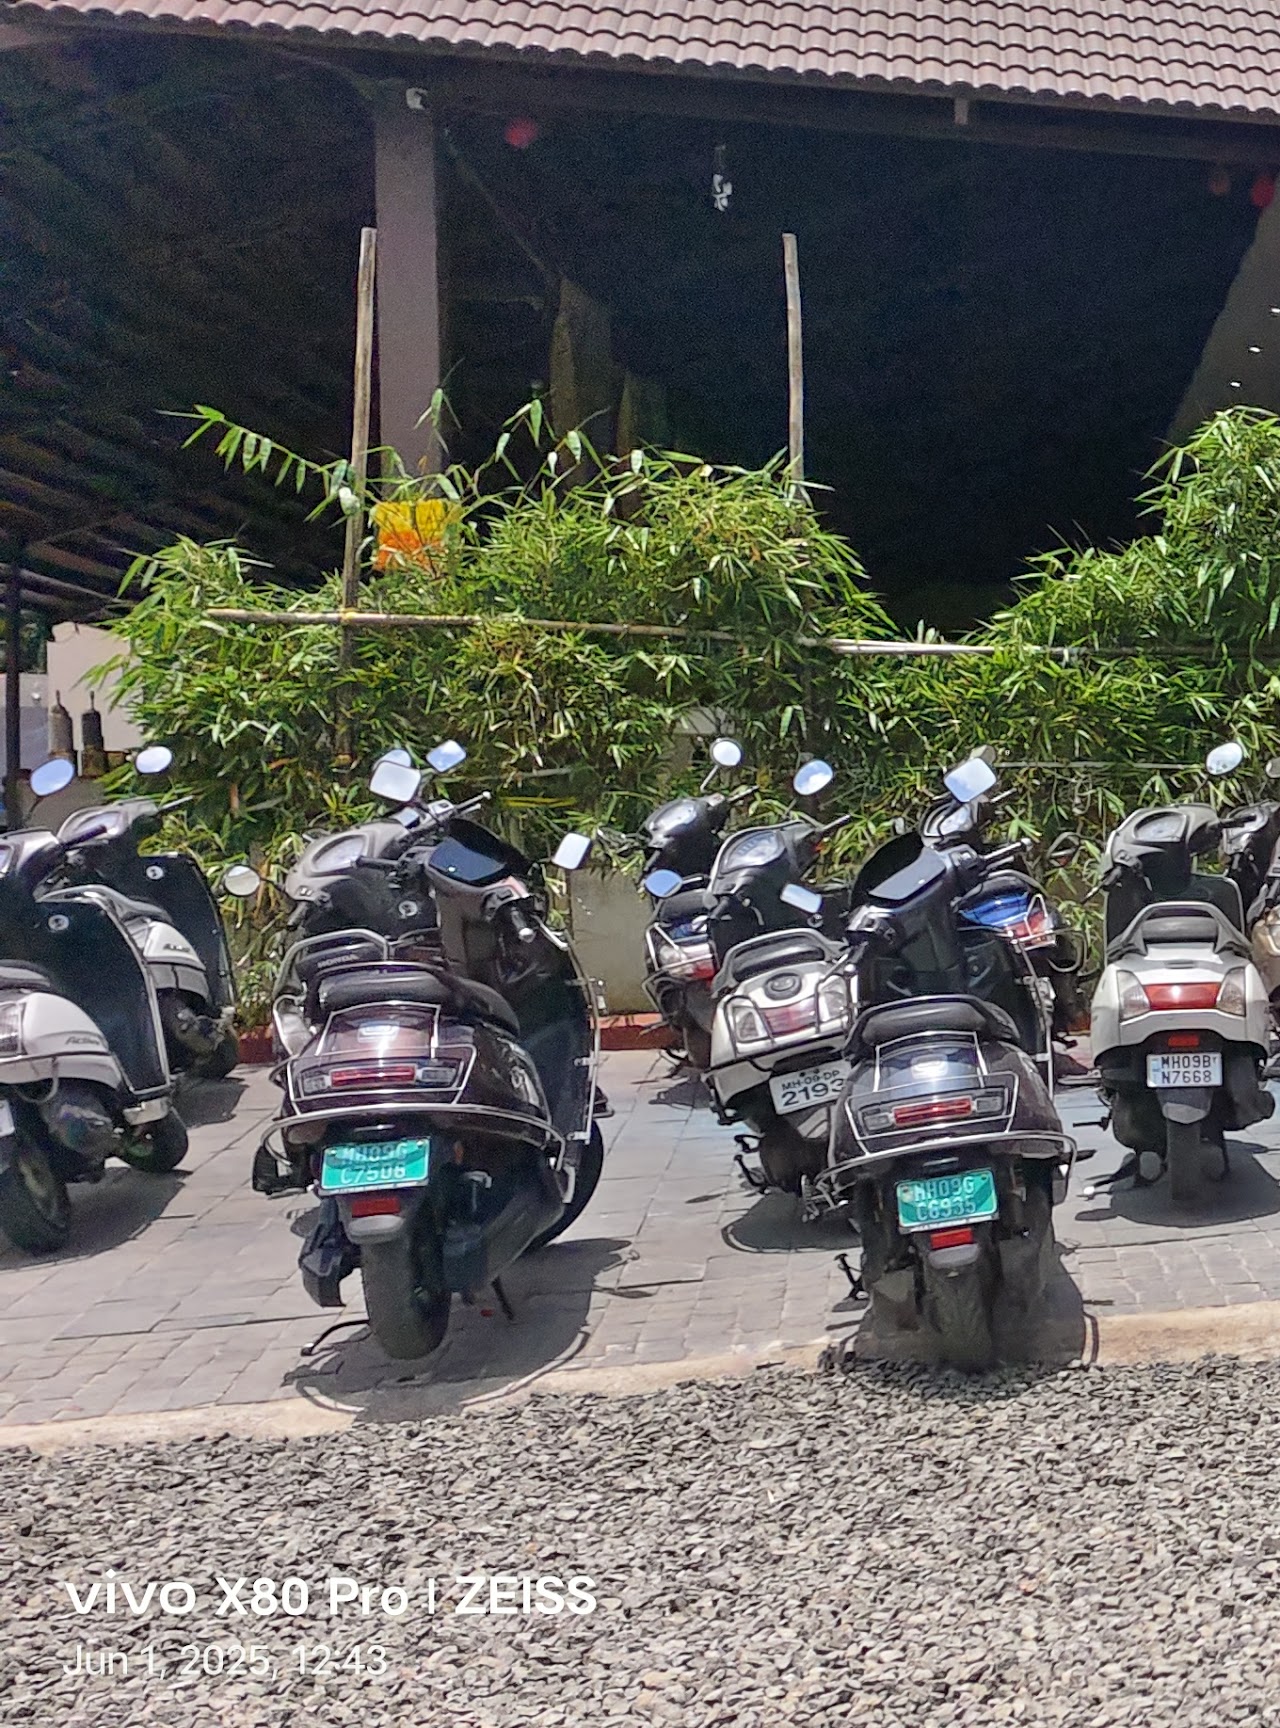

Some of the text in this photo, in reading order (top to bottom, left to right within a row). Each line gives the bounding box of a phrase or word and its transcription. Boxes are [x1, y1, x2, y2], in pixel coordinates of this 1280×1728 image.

[1161, 1054, 1211, 1069] MH09B
[1161, 1070, 1212, 1084] N7668
[781, 1078, 844, 1107] 2193
[913, 1176, 975, 1202] MH09G
